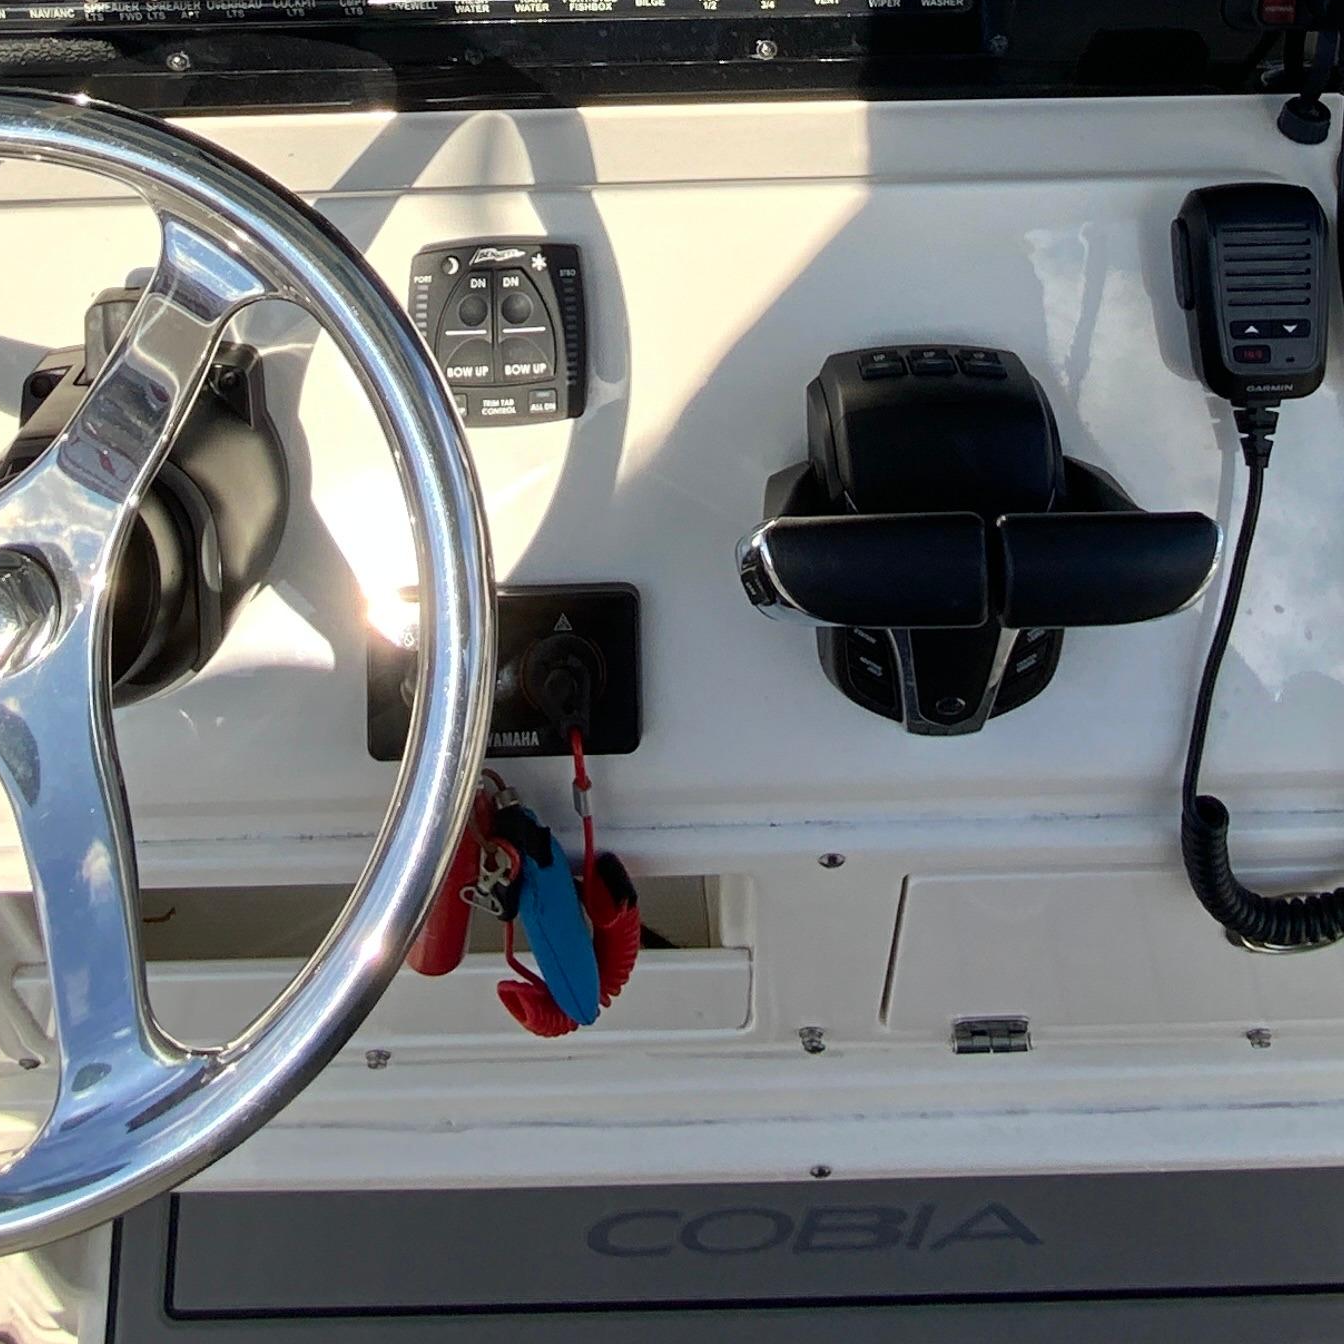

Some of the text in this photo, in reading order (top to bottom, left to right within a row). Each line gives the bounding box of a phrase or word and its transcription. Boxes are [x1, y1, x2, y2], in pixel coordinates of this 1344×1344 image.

[146, 0, 201, 11] SPREADER
[455, 4, 490, 13] WATER
[515, 3, 550, 12] WATER
[569, 2, 613, 11] FISHBOX
[703, 1, 717, 10] 1/2
[760, 1, 775, 10] 3/4
[868, 0, 901, 8] WIPER
[29, 8, 75, 19] NAV/ANC
[147, 11, 166, 20] LTS
[226, 9, 245, 18] LTS
[286, 8, 305, 17] LTS
[344, 7, 364, 16] LTS
[85, 12, 143, 21] LTS FWD
[414, 275, 432, 283] PORT
[470, 278, 486, 288] DN
[502, 276, 519, 287] DN
[873, 354, 886, 362] UP
[447, 365, 489, 377] BOW UP
[505, 362, 547, 375] BOW UP
[1246, 384, 1294, 392] GARMIN
[481, 406, 516, 415] CONTROL
[586, 1199, 1043, 1257] COBIA
